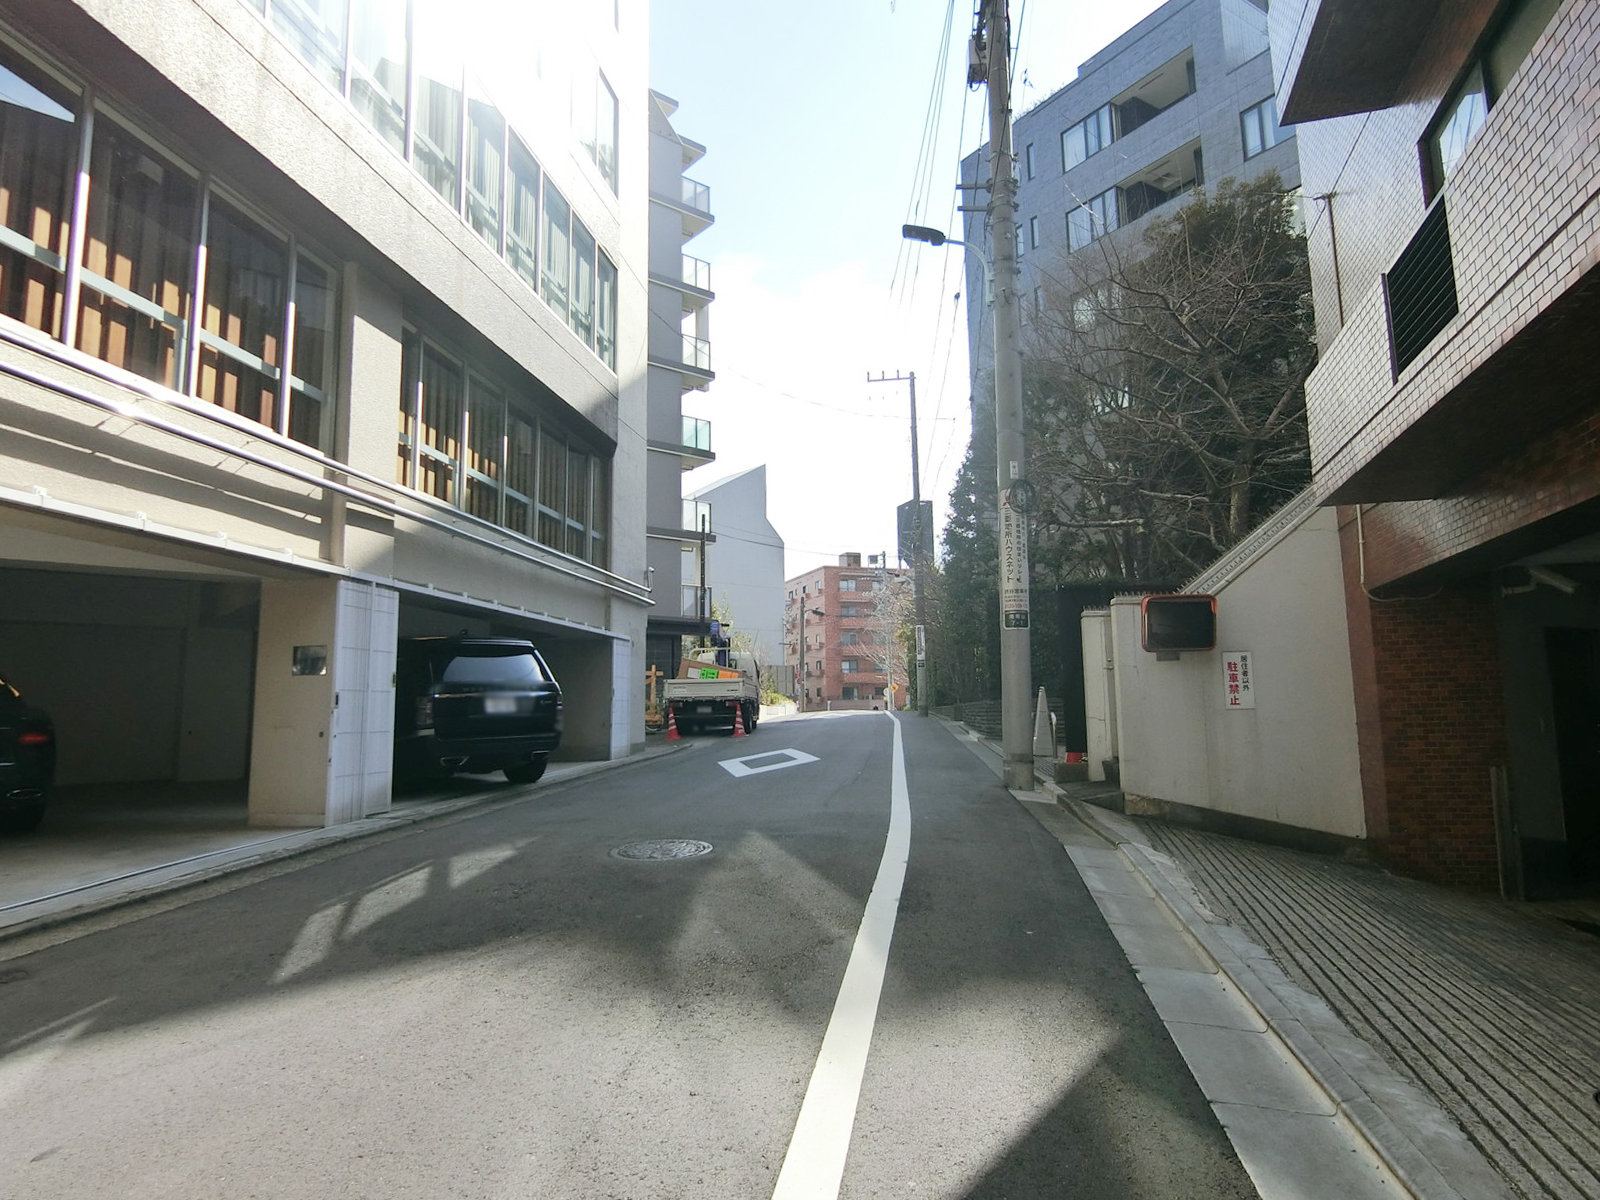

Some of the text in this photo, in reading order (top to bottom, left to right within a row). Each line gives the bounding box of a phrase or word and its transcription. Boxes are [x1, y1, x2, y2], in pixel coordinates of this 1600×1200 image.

[1227, 661, 1240, 705] 駐車禁止
[1240, 655, 1250, 692] 居住者以外
